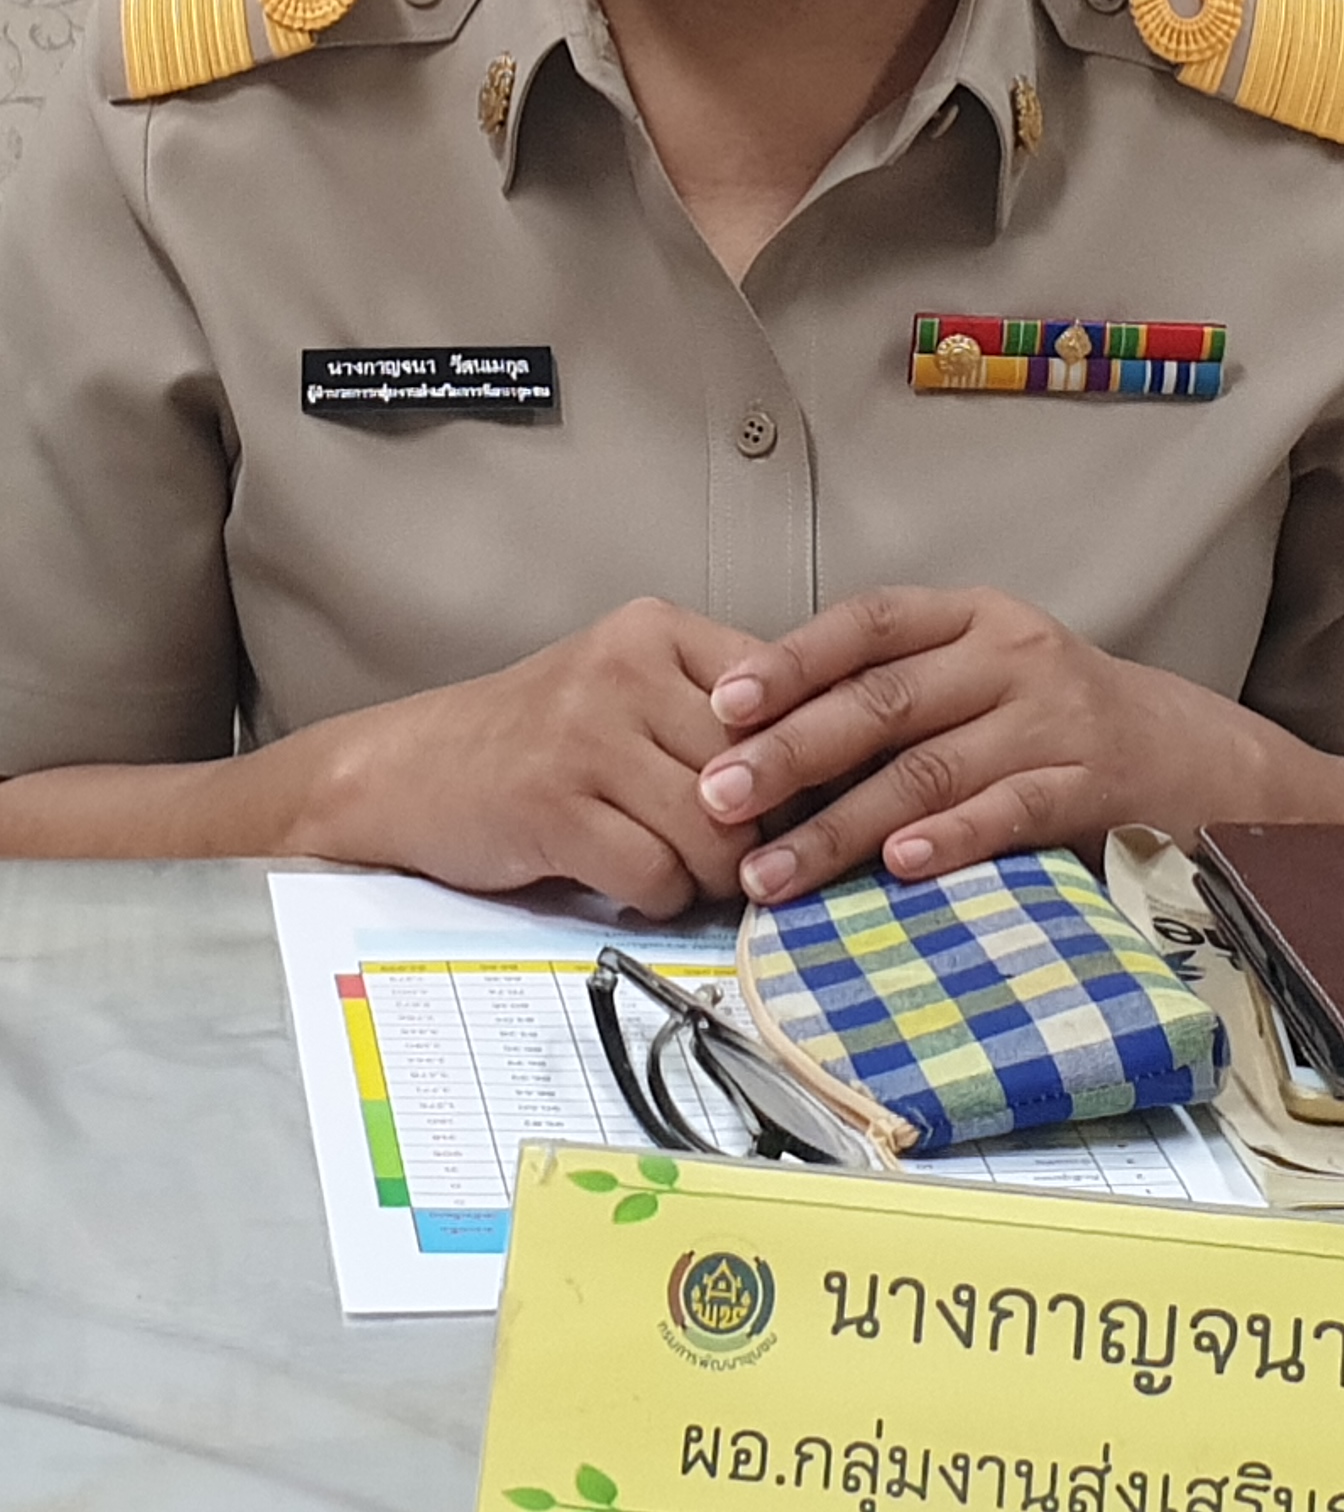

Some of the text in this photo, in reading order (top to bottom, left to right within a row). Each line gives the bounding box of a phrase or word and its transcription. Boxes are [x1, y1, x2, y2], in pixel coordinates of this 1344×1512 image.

[326, 354, 530, 381] นางกาญจนา รัตนเมกุล
